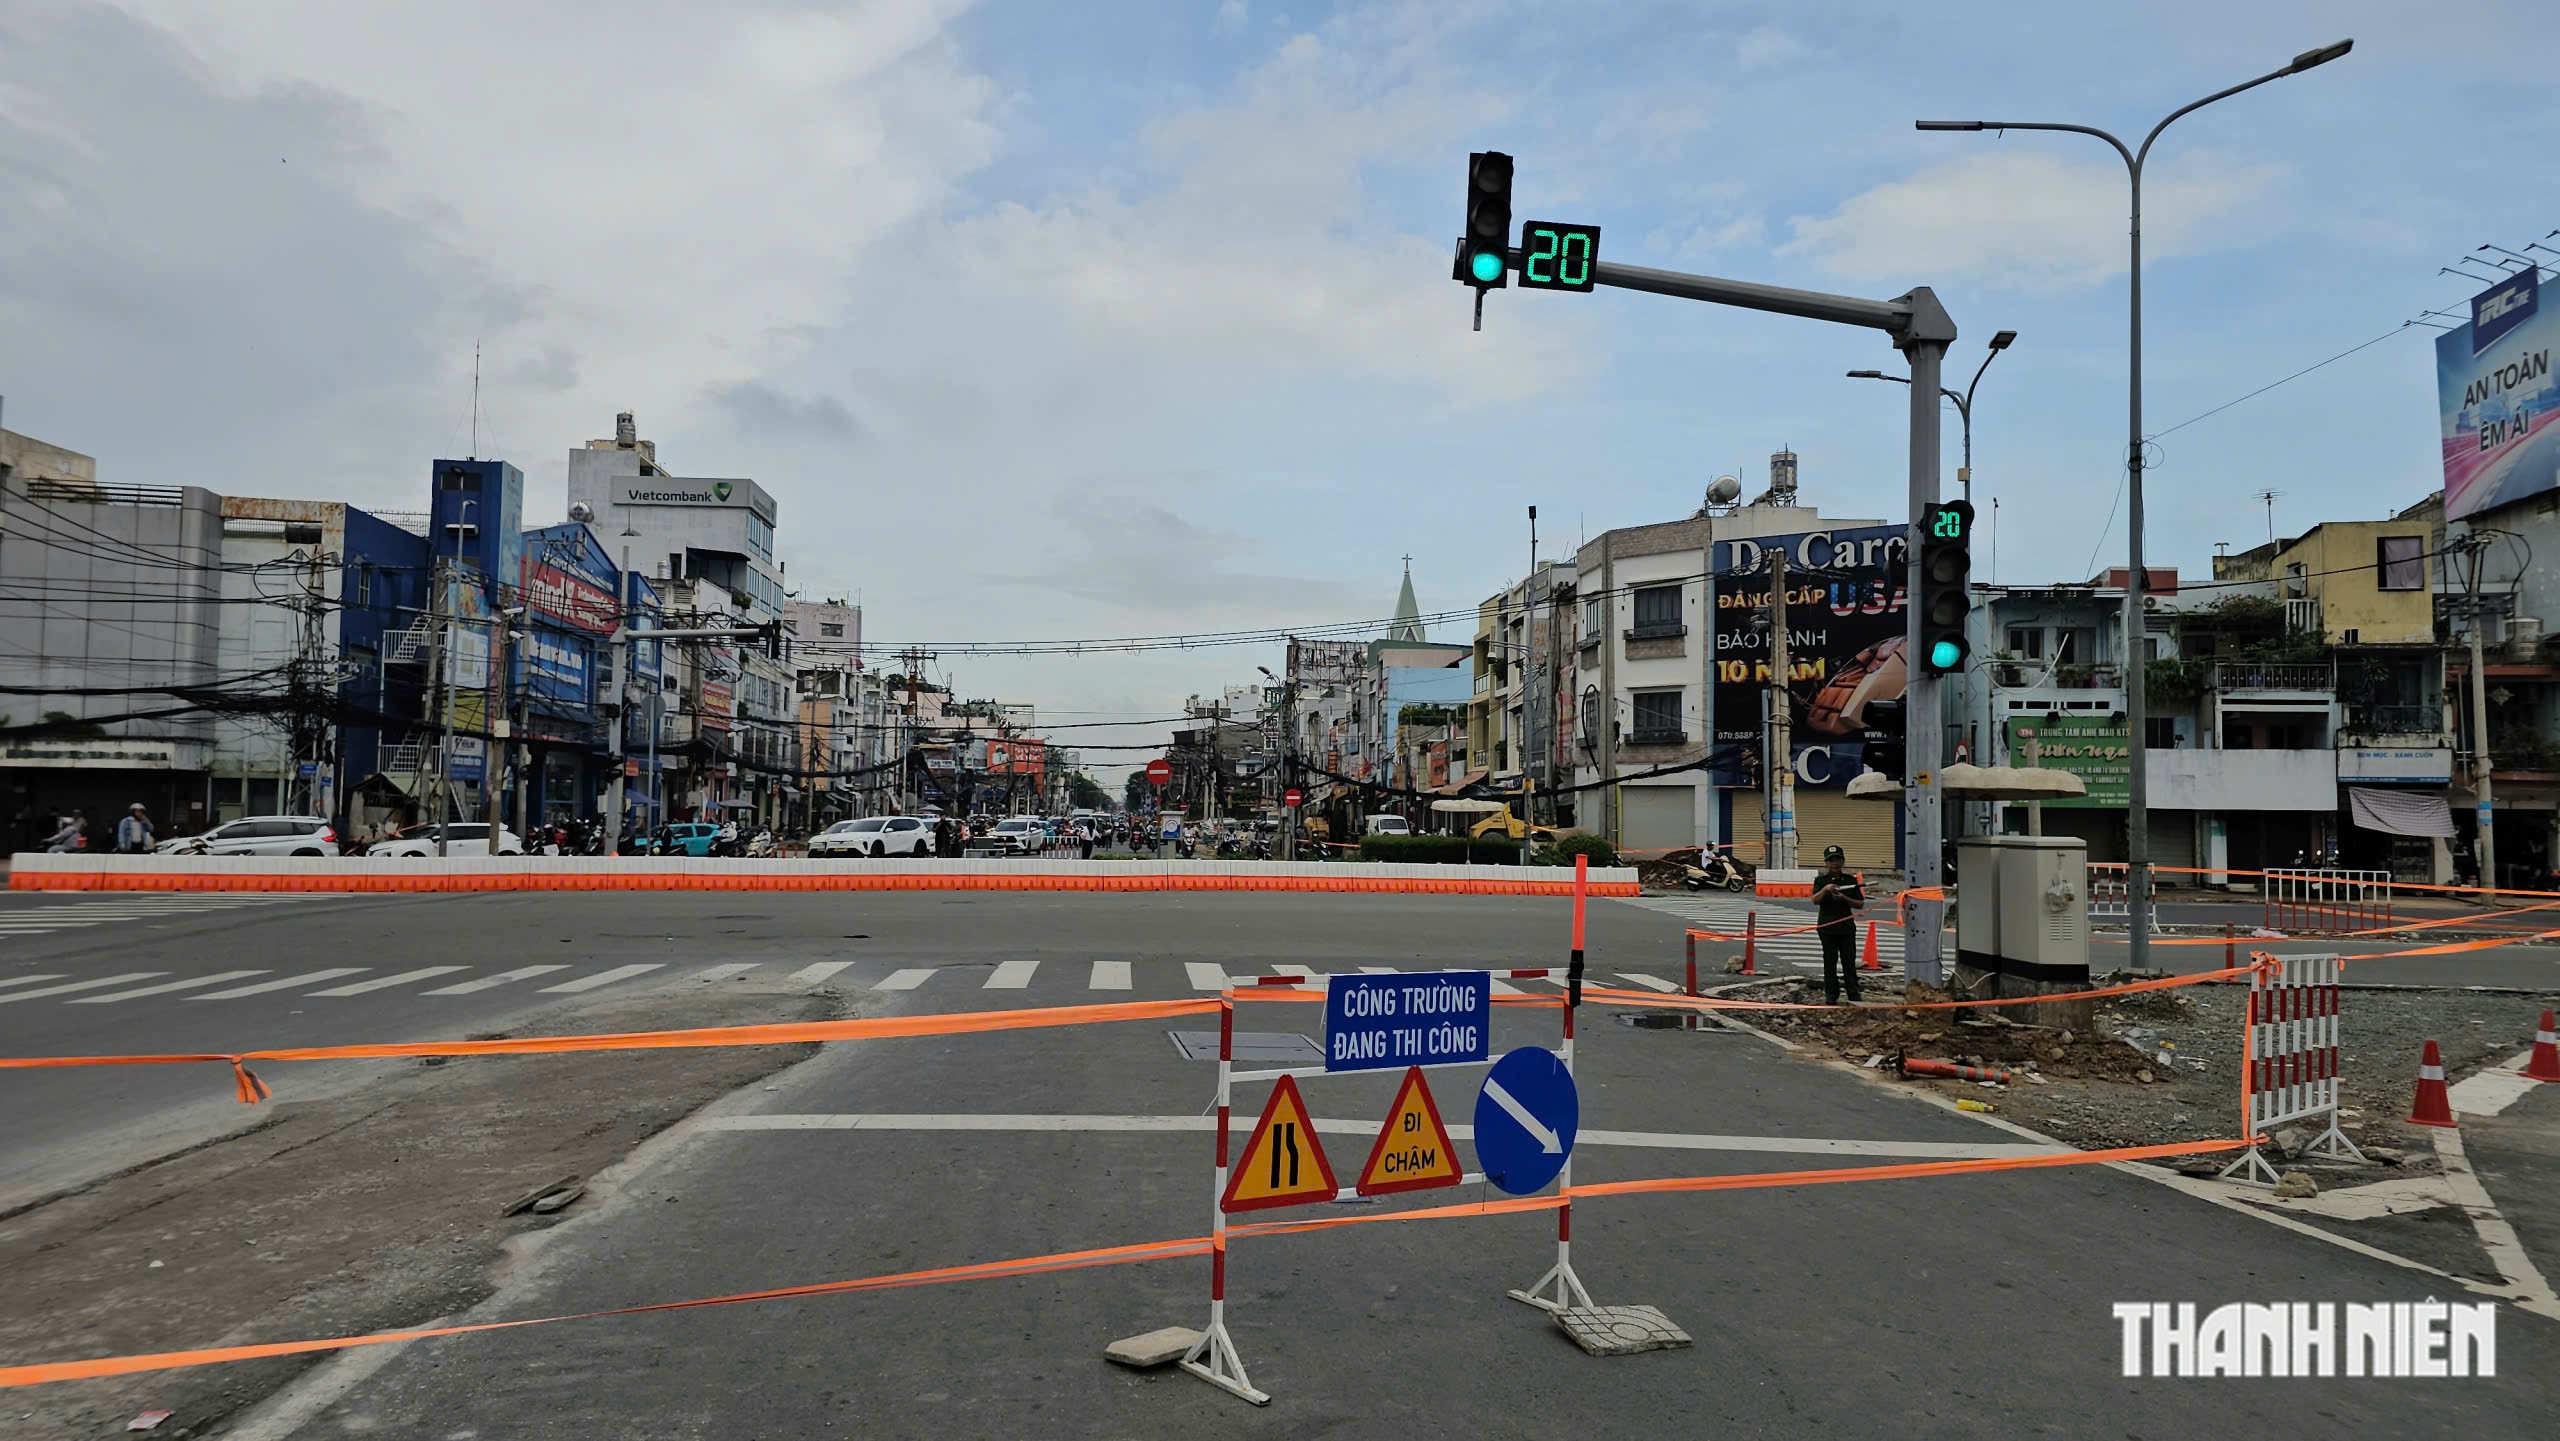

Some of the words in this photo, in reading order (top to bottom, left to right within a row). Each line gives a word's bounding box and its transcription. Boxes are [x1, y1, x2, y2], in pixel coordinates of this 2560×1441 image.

[1527, 229, 1591, 285] 20
[2463, 376, 2489, 410] AN
[2493, 349, 2549, 395] TOÀN
[2479, 418, 2506, 452] ÊM
[2511, 406, 2529, 440] ÁI
[628, 489, 712, 503] Vietcombank
[1934, 511, 1960, 537] 20
[1717, 628, 1760, 650] BẢO
[1717, 659, 1749, 683] 10
[1344, 982, 1396, 1018] CÔNG
[1402, 978, 1476, 1015] TRƯỜNG
[1333, 1030, 1387, 1061] ĐANG
[1393, 1028, 1422, 1057] THI
[1428, 1021, 1477, 1055] CÔNG
[1403, 1112, 1422, 1133] ĐI
[1384, 1145, 1435, 1176] CHẬM
